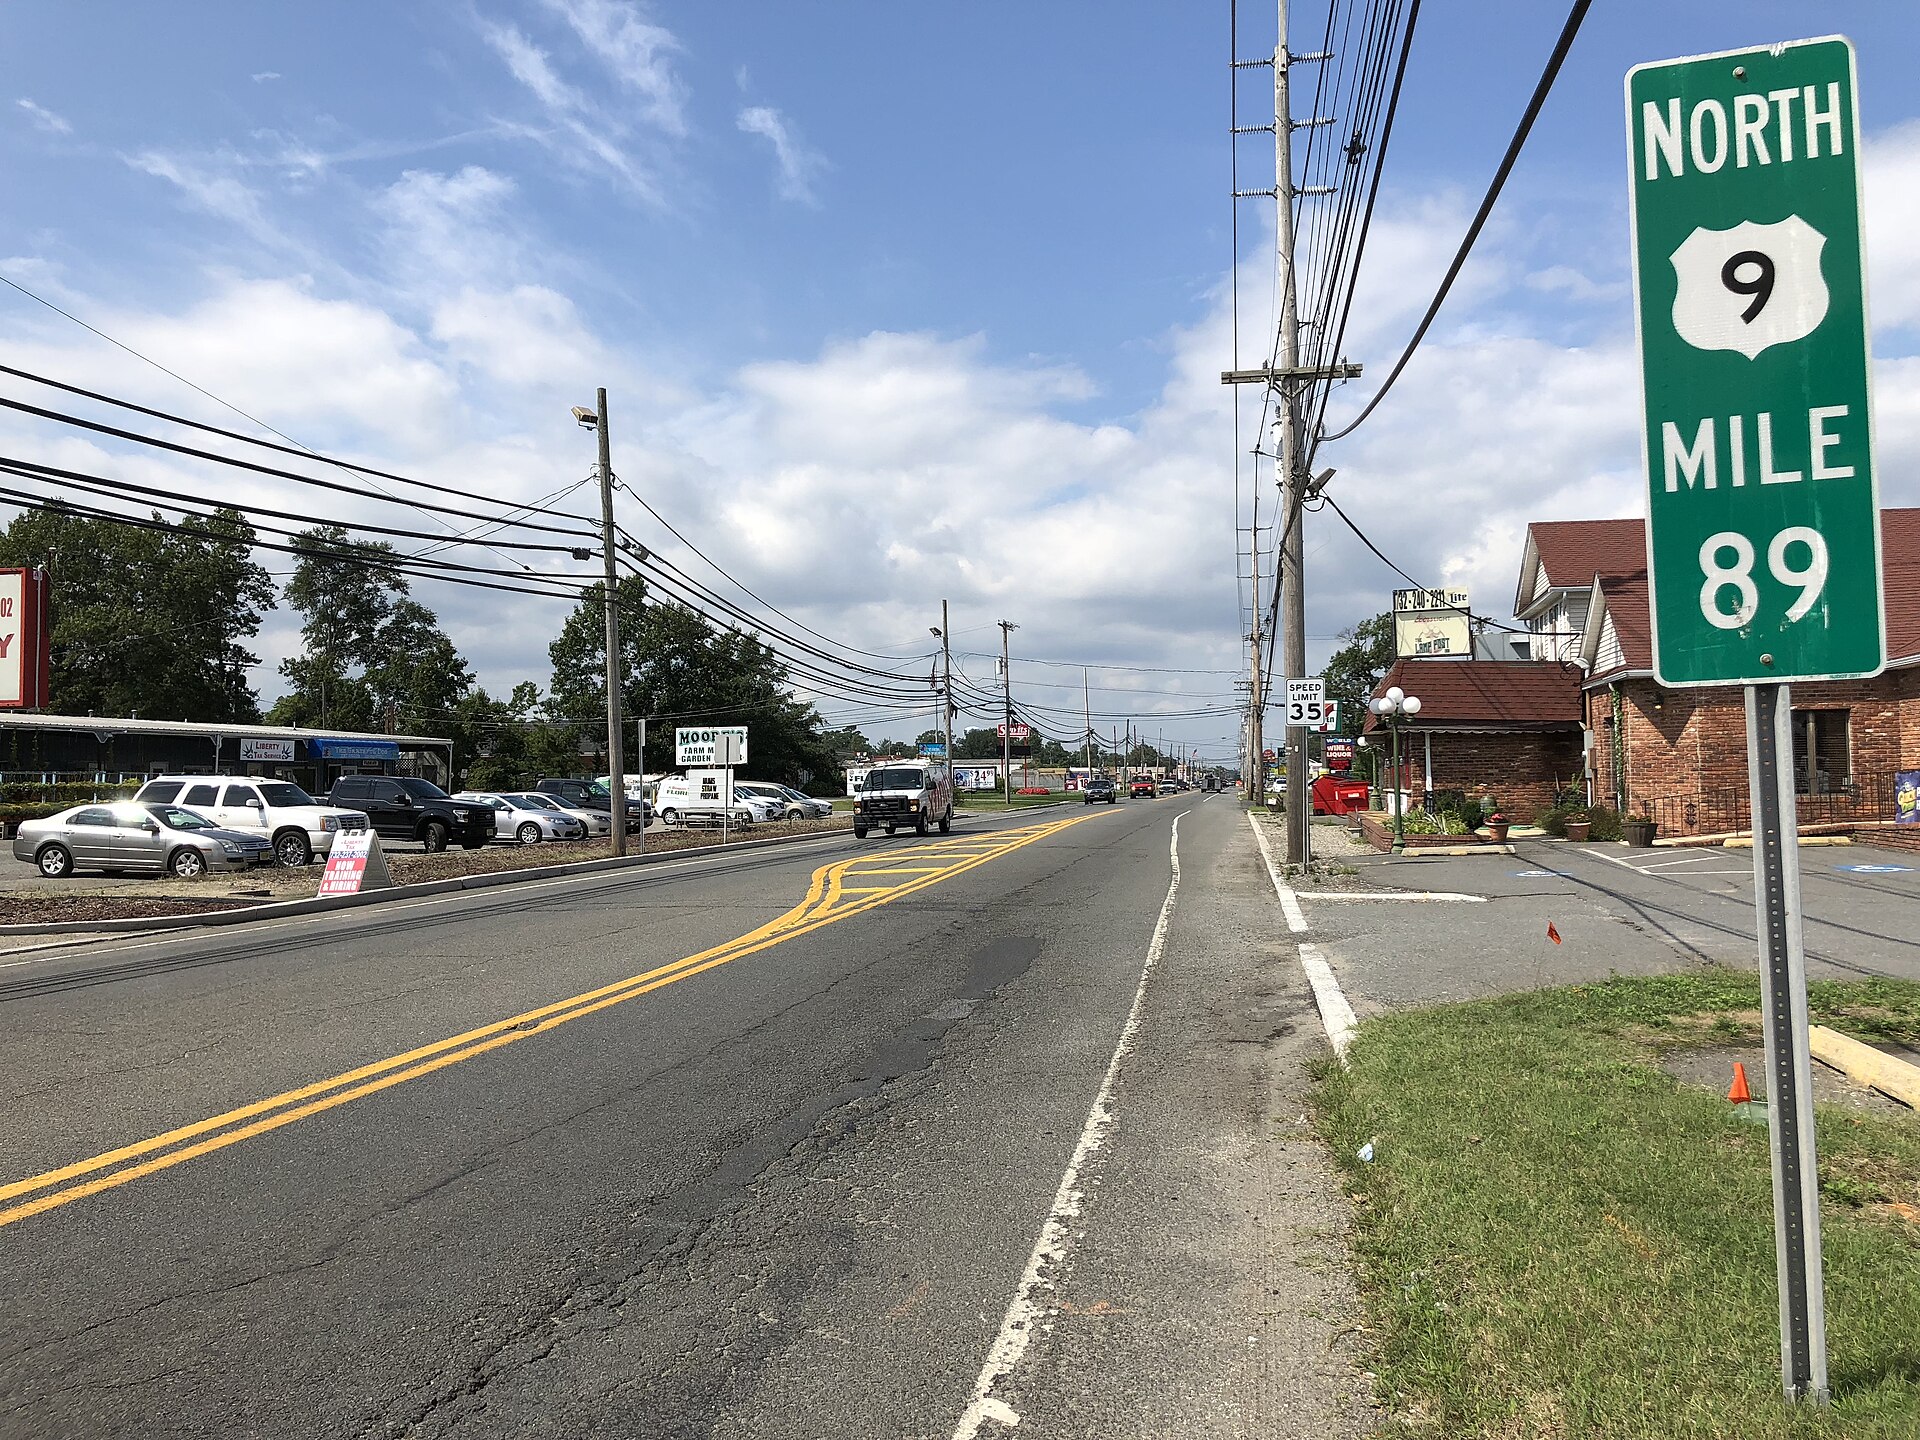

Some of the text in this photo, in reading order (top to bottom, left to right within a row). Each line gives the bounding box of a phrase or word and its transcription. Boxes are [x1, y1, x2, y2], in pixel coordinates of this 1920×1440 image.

[1643, 81, 1843, 181] NORTH
[1721, 250, 1775, 325] 9
[1661, 404, 1855, 493] MILE
[1699, 526, 1829, 630] 89
[1289, 683, 1322, 692] SPEED
[1292, 693, 1318, 701] LIMIT
[1289, 703, 1322, 721] 35
[255, 741, 280, 750] LIBERTY
[684, 747, 705, 755] FARM
[681, 755, 711, 763] GARDEN
[700, 792, 720, 800] PROPANE
[335, 860, 356, 871] NOW
[324, 870, 362, 881] TRAINING
[329, 880, 358, 891] HIRING
